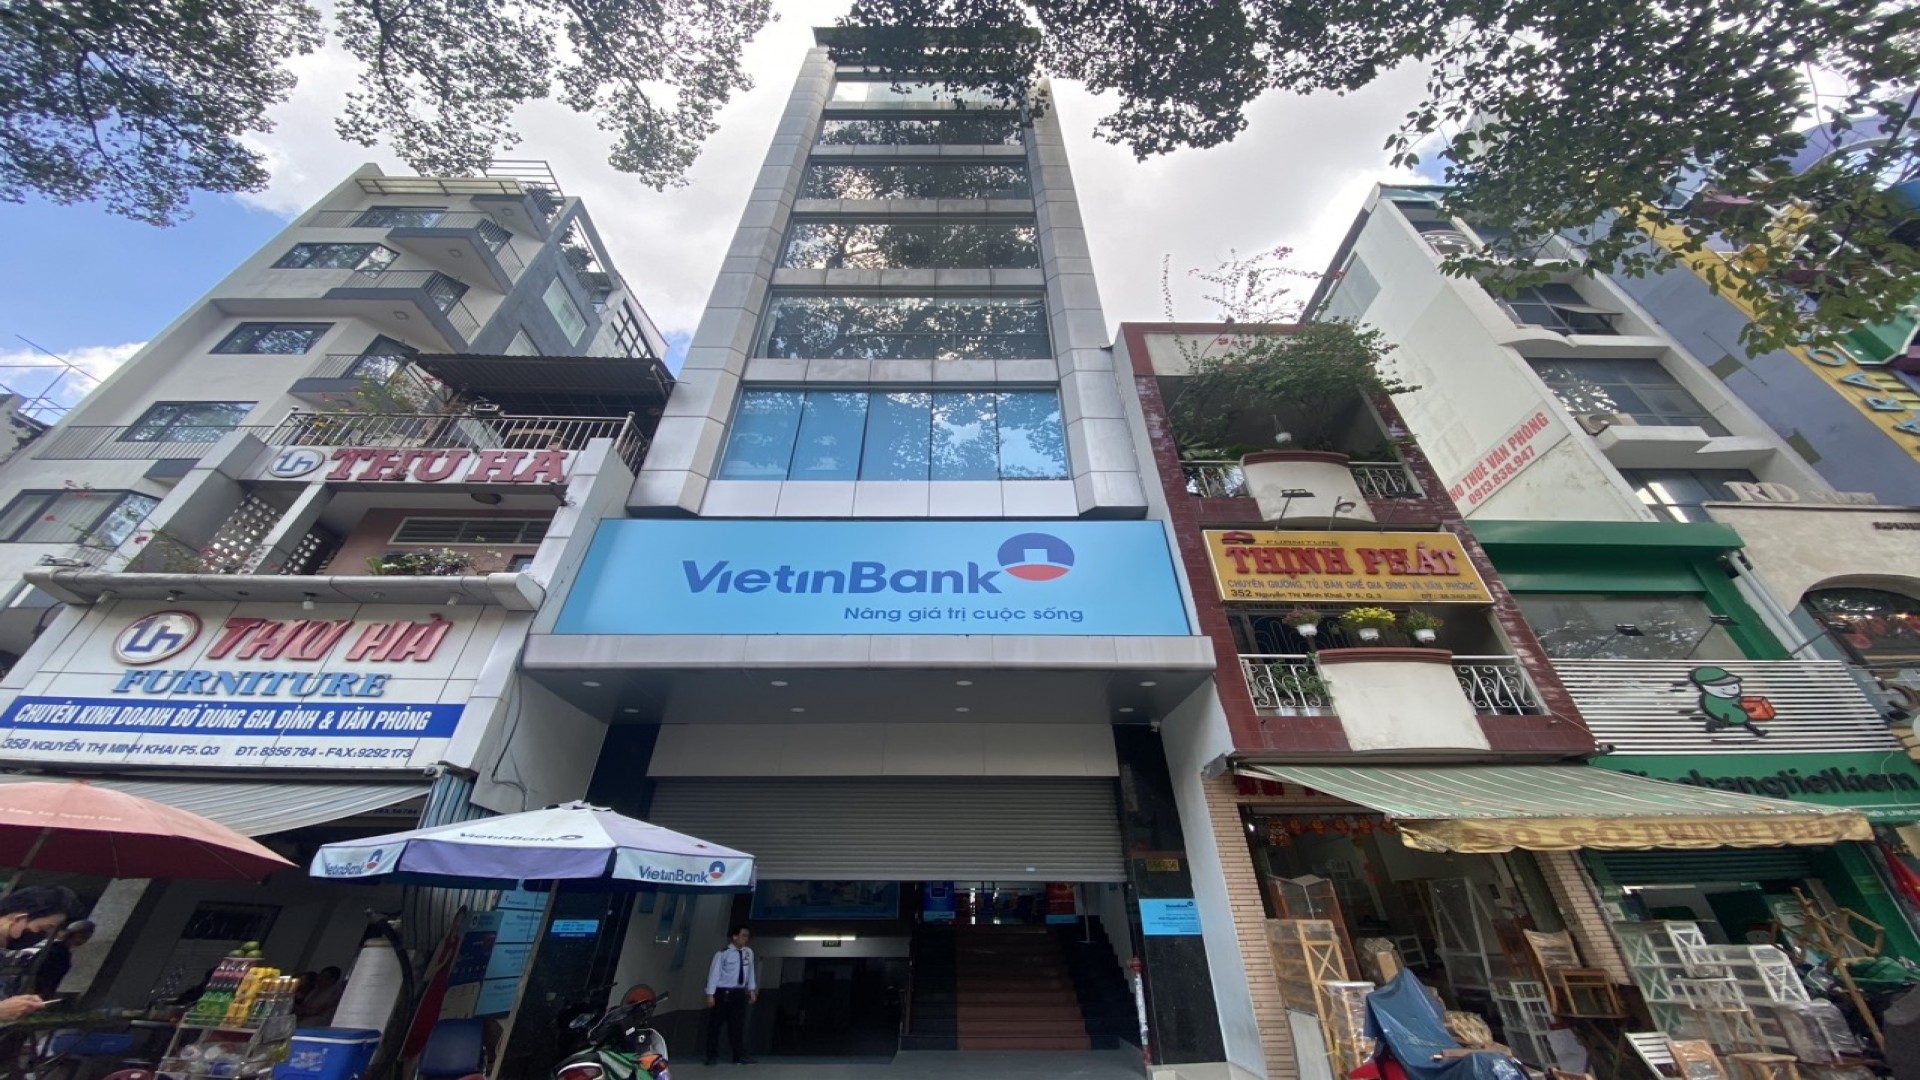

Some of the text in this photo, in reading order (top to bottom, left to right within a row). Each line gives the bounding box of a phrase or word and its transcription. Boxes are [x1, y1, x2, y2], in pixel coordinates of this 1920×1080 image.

[325, 448, 469, 481] THU
[1462, 461, 1489, 490] THUÊ
[1508, 412, 1549, 451] PHÒNG
[1225, 547, 1353, 578] THỊNH
[682, 560, 1004, 594] VietinBank
[1227, 578, 1264, 589] CHUYÊN
[1367, 580, 1382, 590] GIA
[1230, 590, 1252, 598] 352
[843, 605, 1083, 622] Nâng giá trị cuộc sống
[206, 617, 354, 660] THU
[345, 613, 453, 661] HÀ
[112, 669, 391, 697] FURNITURE
[13, 701, 80, 724] CHUYÊN
[74, 706, 120, 726] KINH
[113, 707, 175, 727] DOANH
[243, 709, 277, 729] GIA
[274, 705, 320, 730] ĐÌNH
[318, 711, 334, 730] &
[337, 707, 373, 730] VĂN
[371, 706, 432, 731] PHÒNG
[2, 738, 31, 750] 358
[87, 743, 109, 755] THỊ
[107, 743, 142, 754] MINH
[142, 745, 178, 755] KHAI
[460, 832, 555, 842] VietinBank
[639, 865, 708, 883] VietinBank
